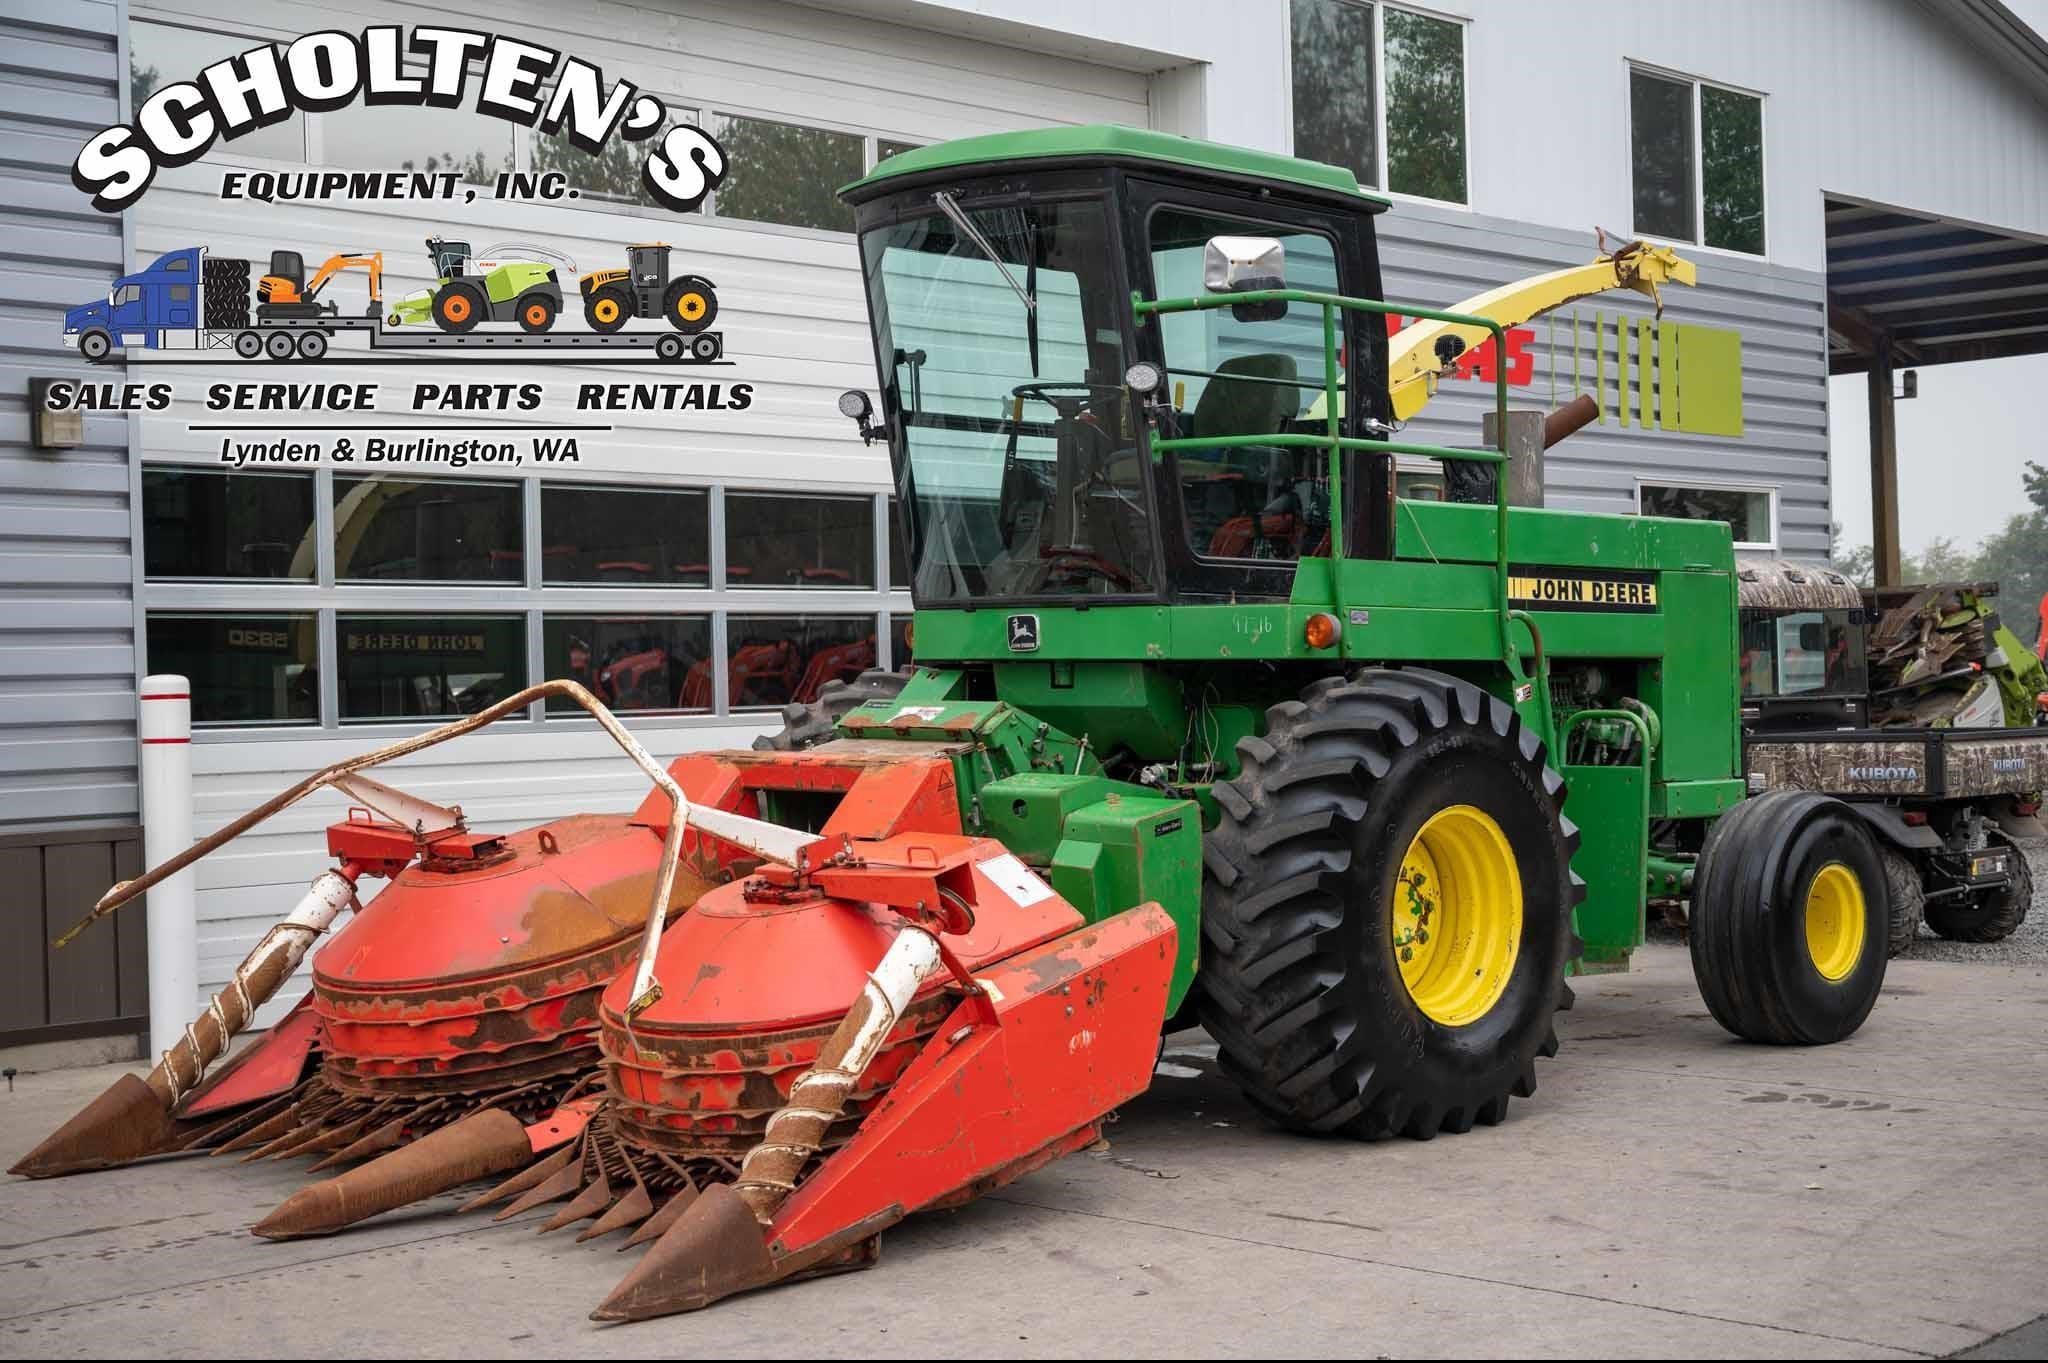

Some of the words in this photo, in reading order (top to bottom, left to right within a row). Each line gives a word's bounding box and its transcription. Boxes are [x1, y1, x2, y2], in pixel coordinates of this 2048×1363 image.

[1532, 579, 1583, 600] JOHN
[1592, 582, 1651, 604] DEERE
[1993, 758, 2026, 770] KUBOTA
[1849, 767, 1918, 780] KUBOTA
